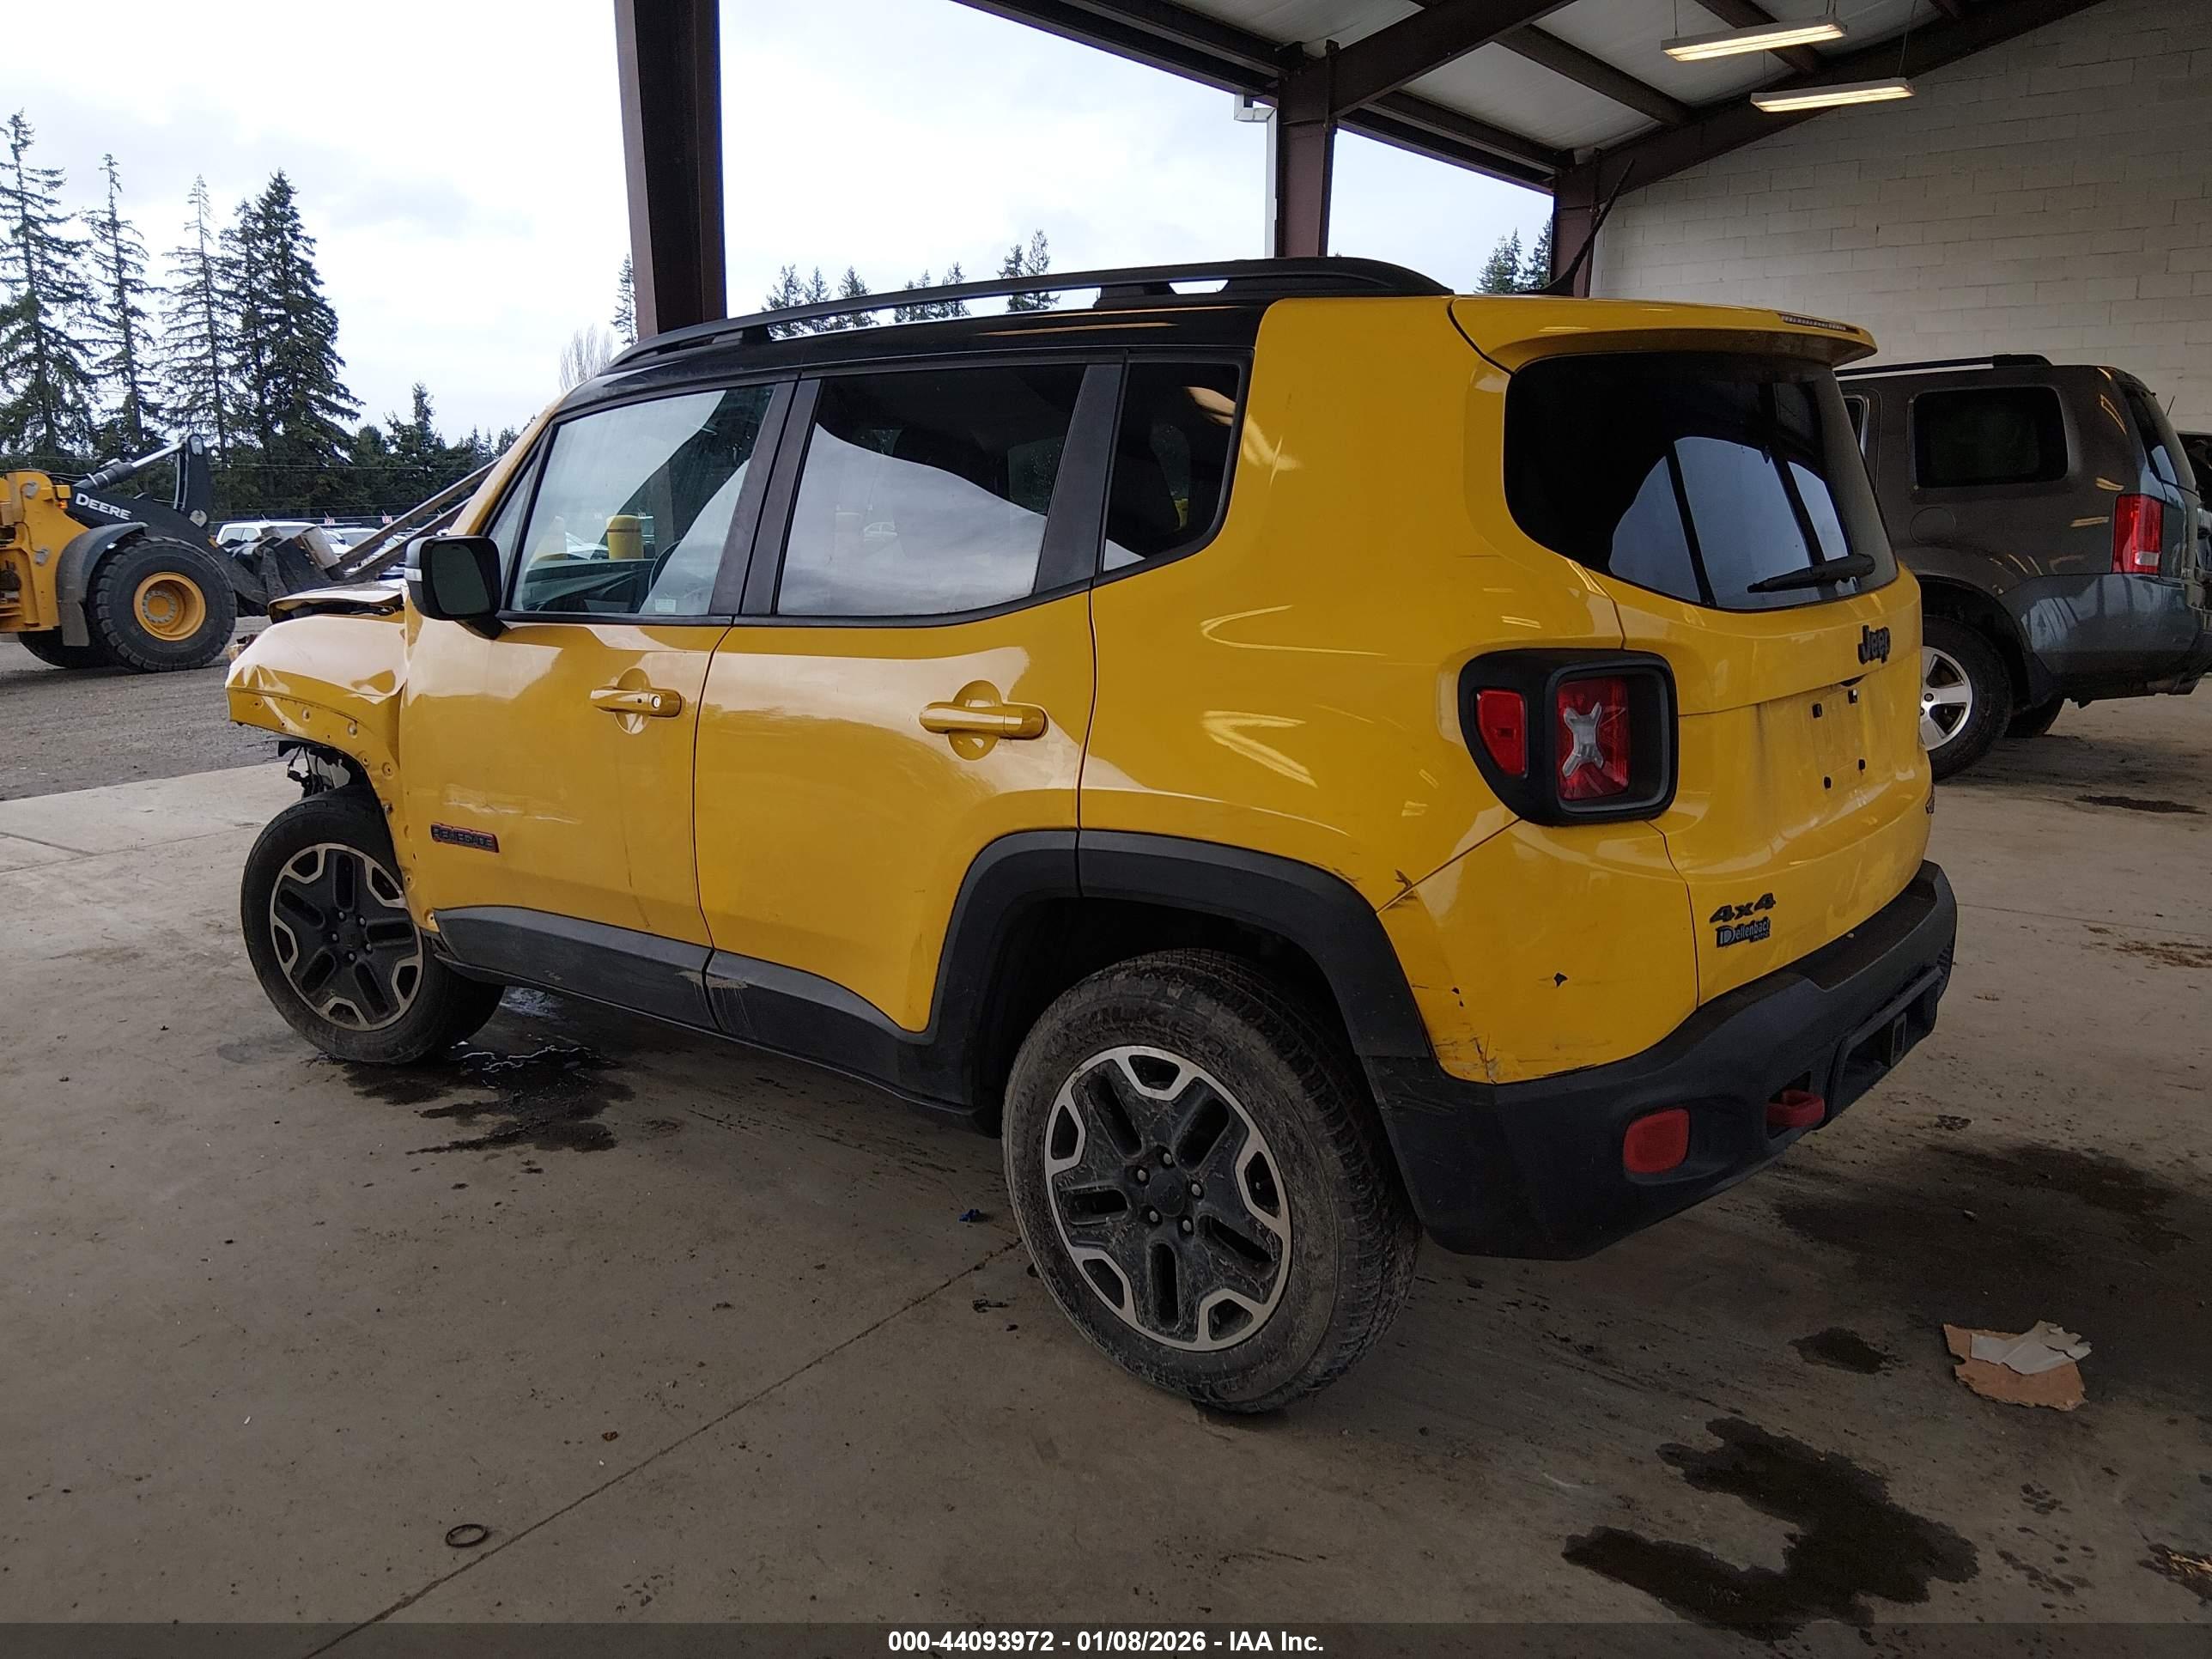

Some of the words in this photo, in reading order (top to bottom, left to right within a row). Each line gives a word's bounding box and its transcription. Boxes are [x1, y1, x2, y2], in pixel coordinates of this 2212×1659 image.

[75, 493, 132, 520] DEERE
[1857, 624, 1891, 665] Jeep
[1710, 892, 1776, 923] 4x4
